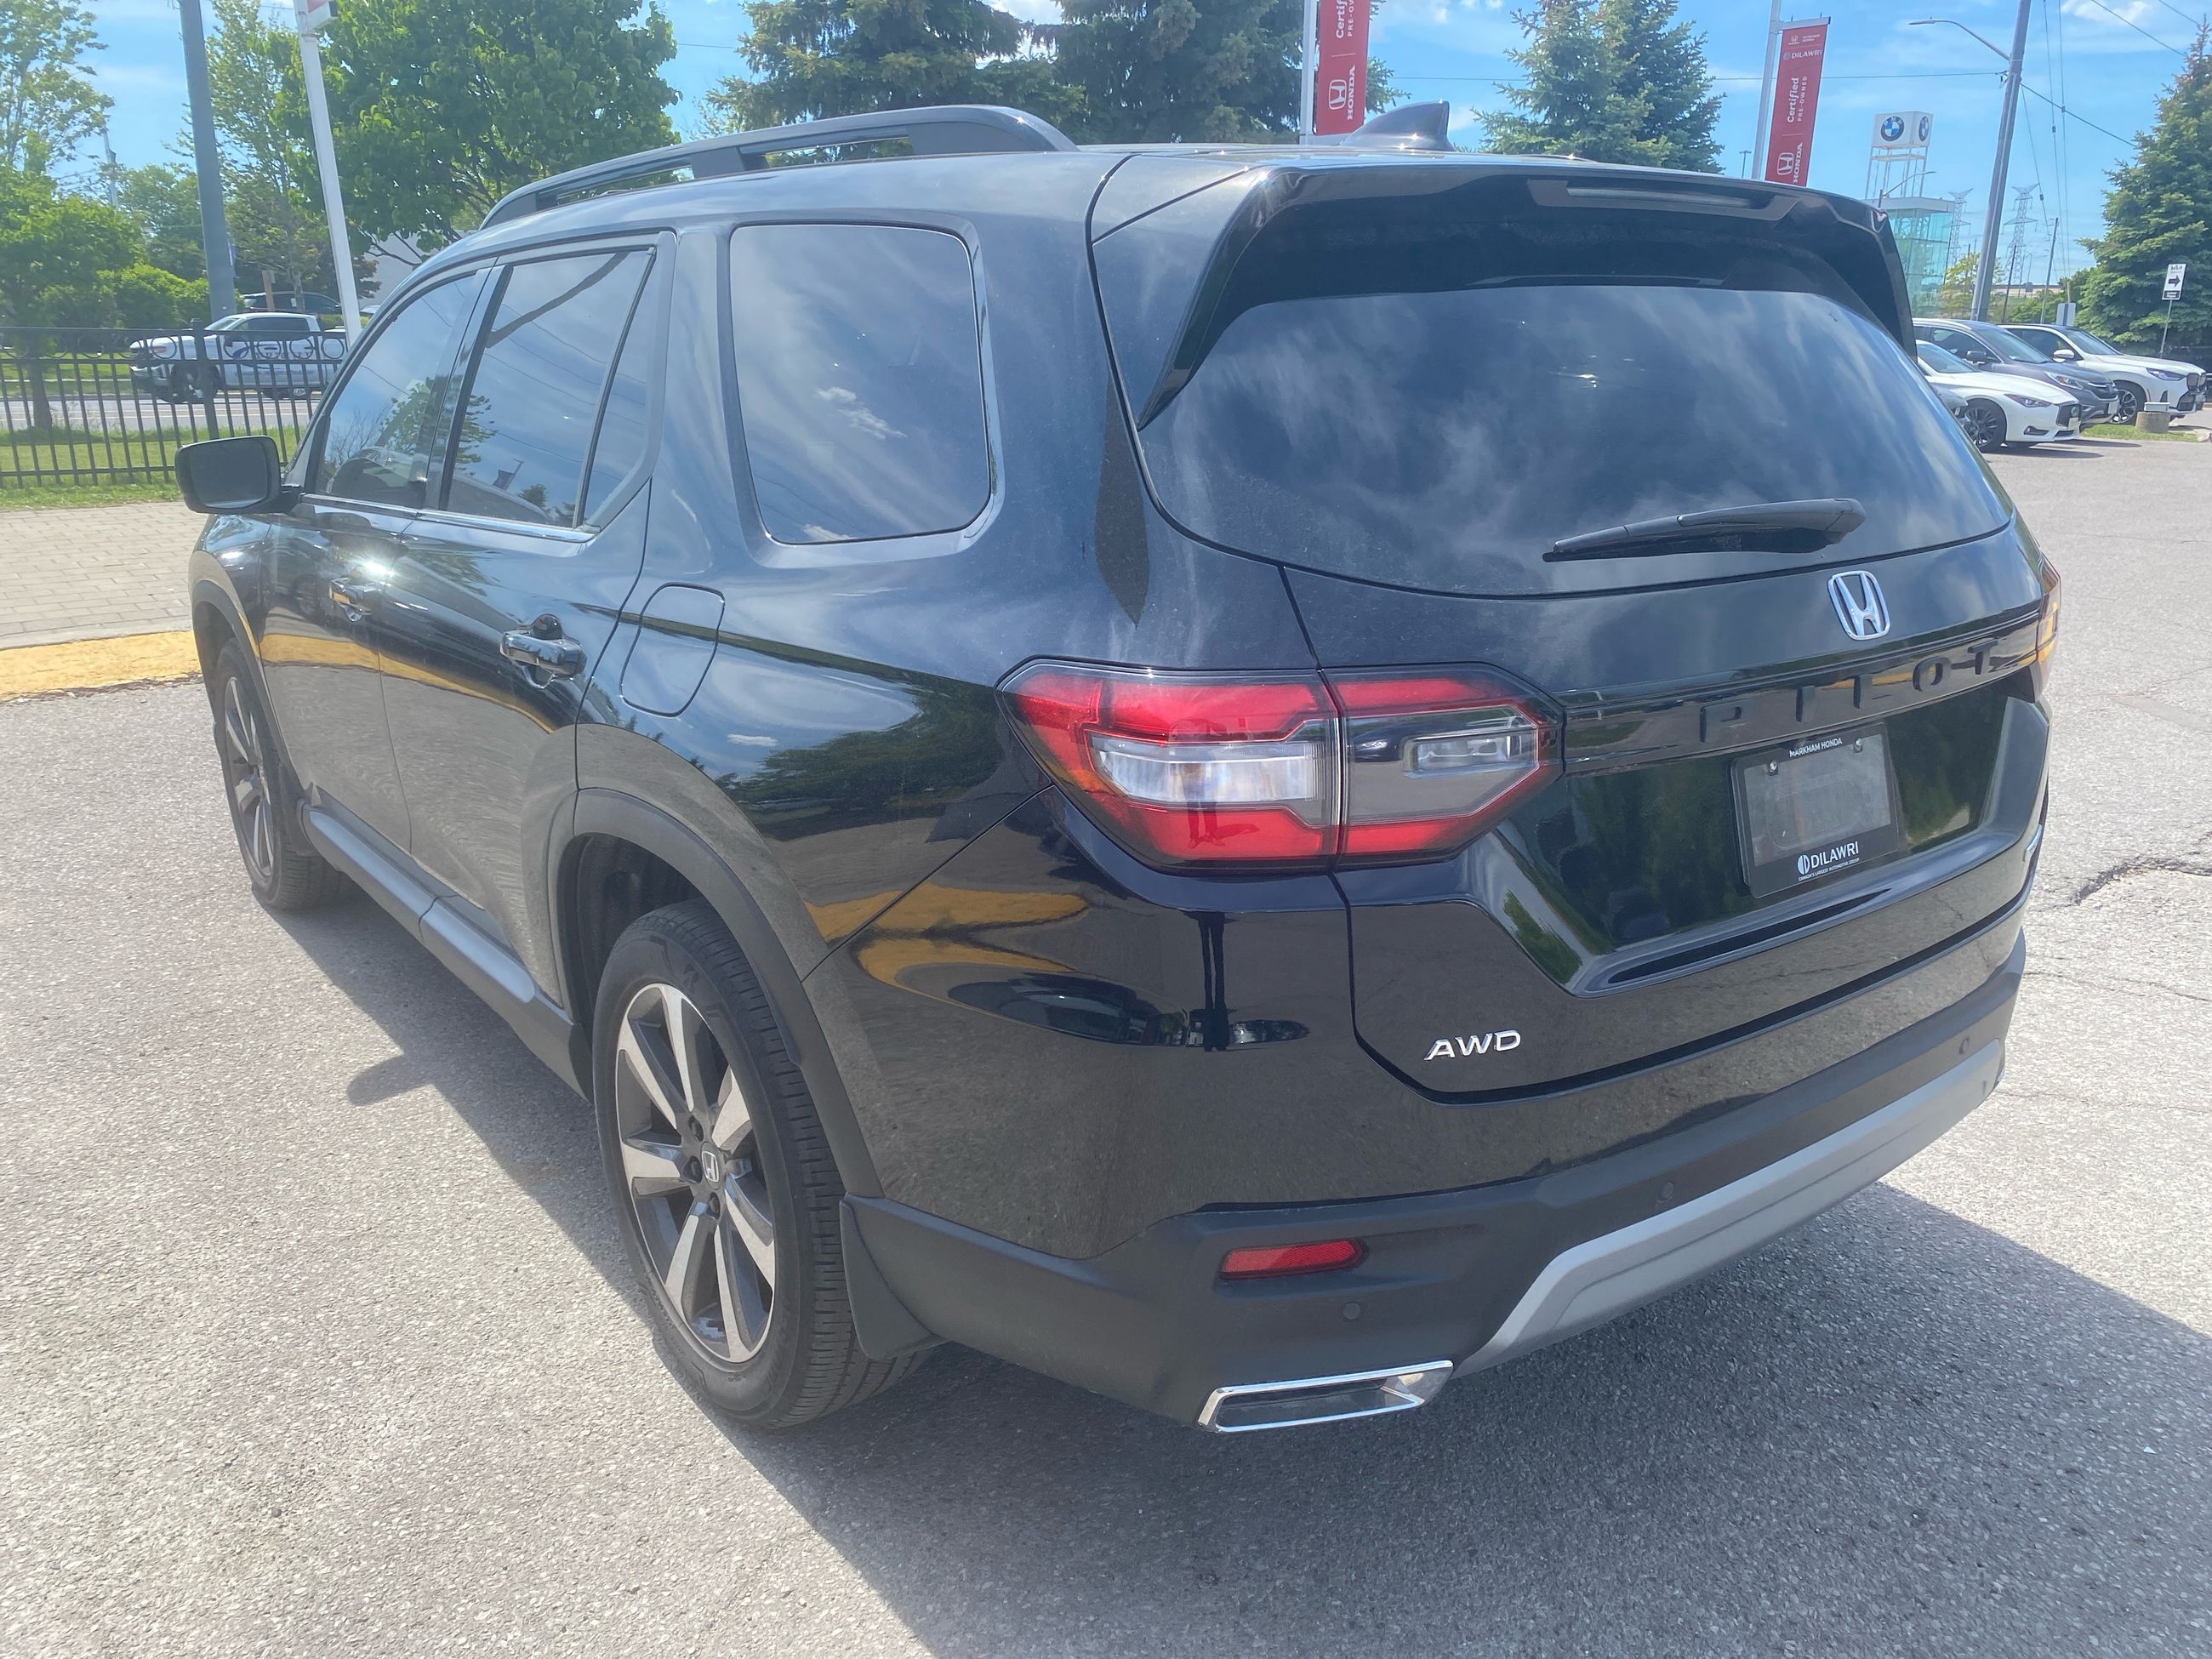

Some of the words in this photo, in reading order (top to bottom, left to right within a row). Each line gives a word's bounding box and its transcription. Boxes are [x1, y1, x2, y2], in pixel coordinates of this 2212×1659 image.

[1336, 0, 1348, 39] Certif
[1791, 49, 1822, 60] DILAWRI
[1347, 64, 1356, 121] HONDA
[1787, 77, 1799, 123] Certified
[1797, 76, 1808, 122] PRE-OWNED
[1793, 142, 1803, 184] HONDA
[1789, 742, 1821, 758] MARKHAM
[1821, 738, 1843, 750] HONDA
[1810, 841, 1859, 869] DILAWRI
[1423, 1029, 1521, 1061] AWD
